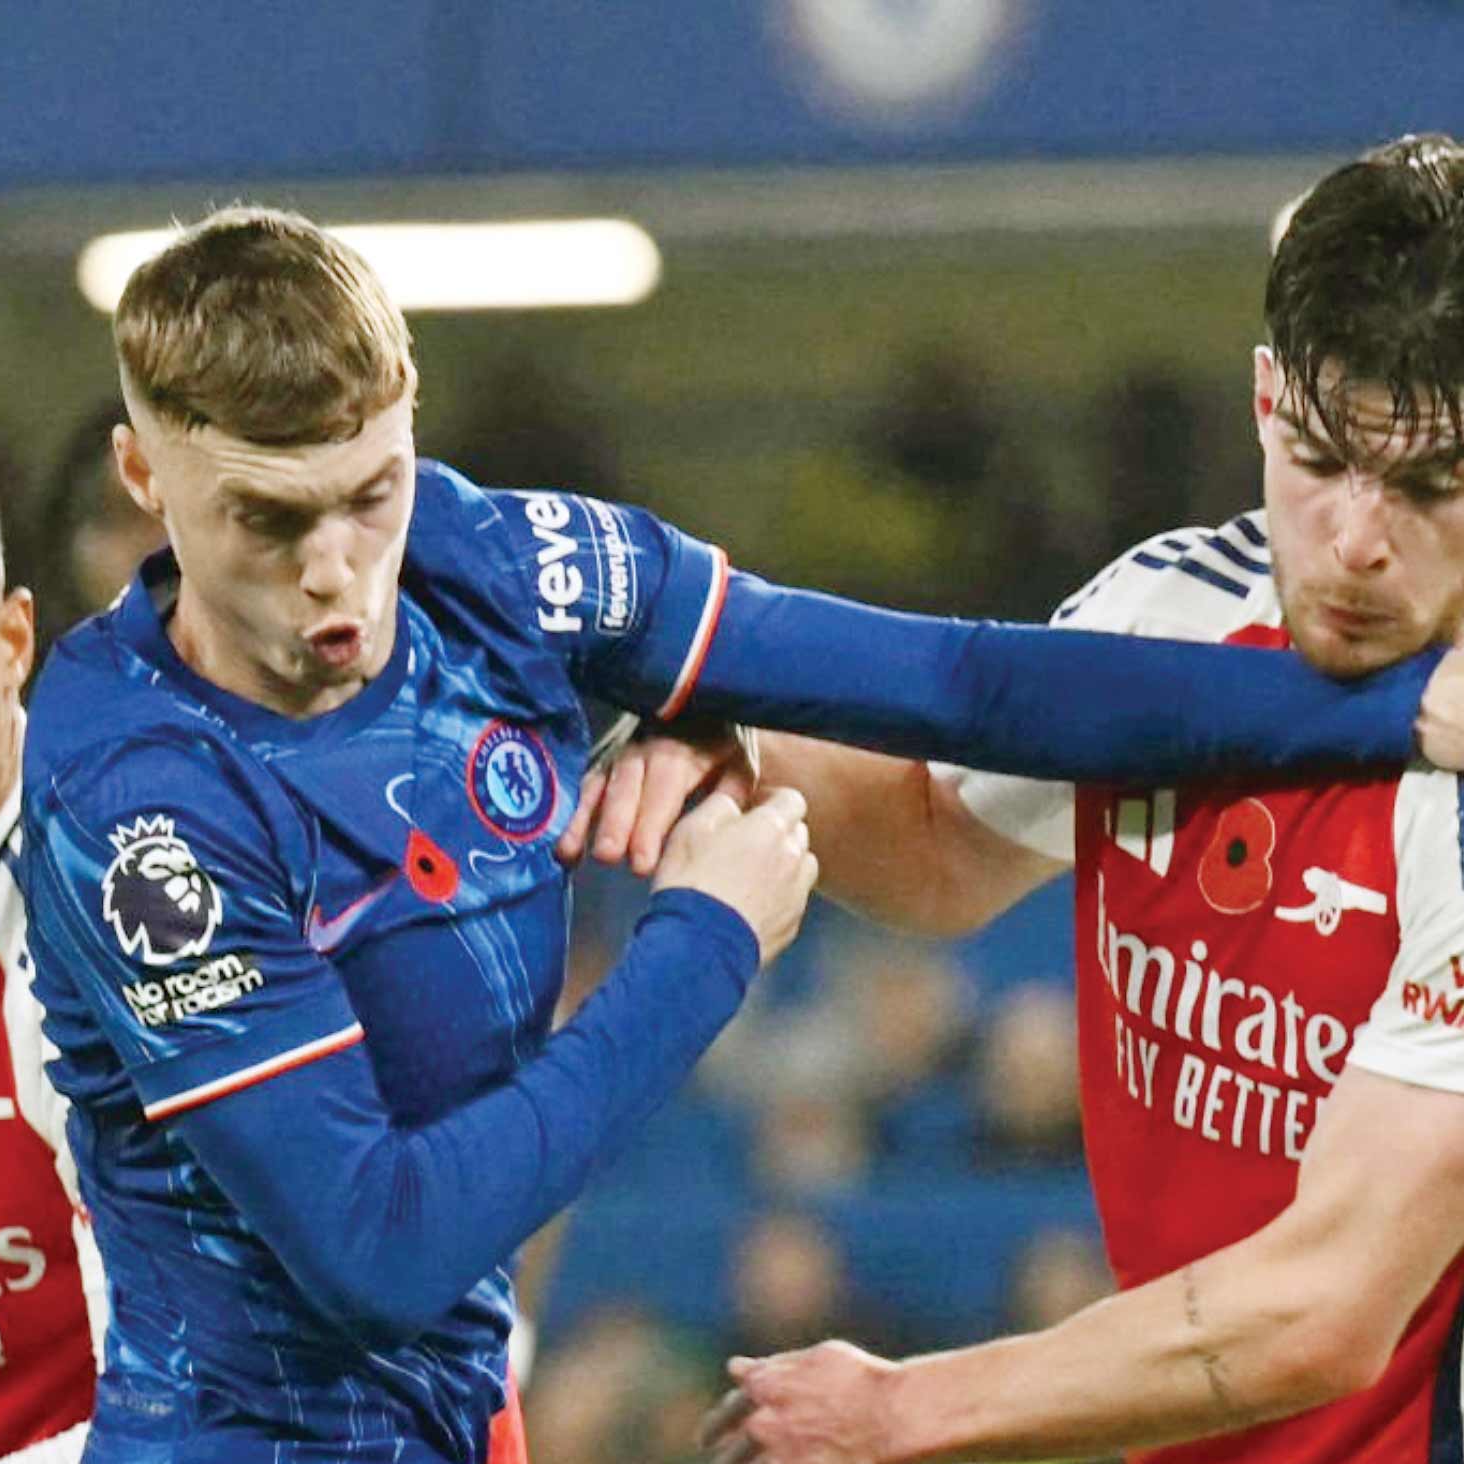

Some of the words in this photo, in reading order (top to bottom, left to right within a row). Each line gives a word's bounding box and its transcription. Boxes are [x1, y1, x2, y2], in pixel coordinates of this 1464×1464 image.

[524, 490, 584, 633] feve
[122, 980, 164, 1007] No
[164, 954, 244, 998] room
[1114, 1011, 1160, 1109] FLY
[1174, 1053, 1327, 1163] BETTE
